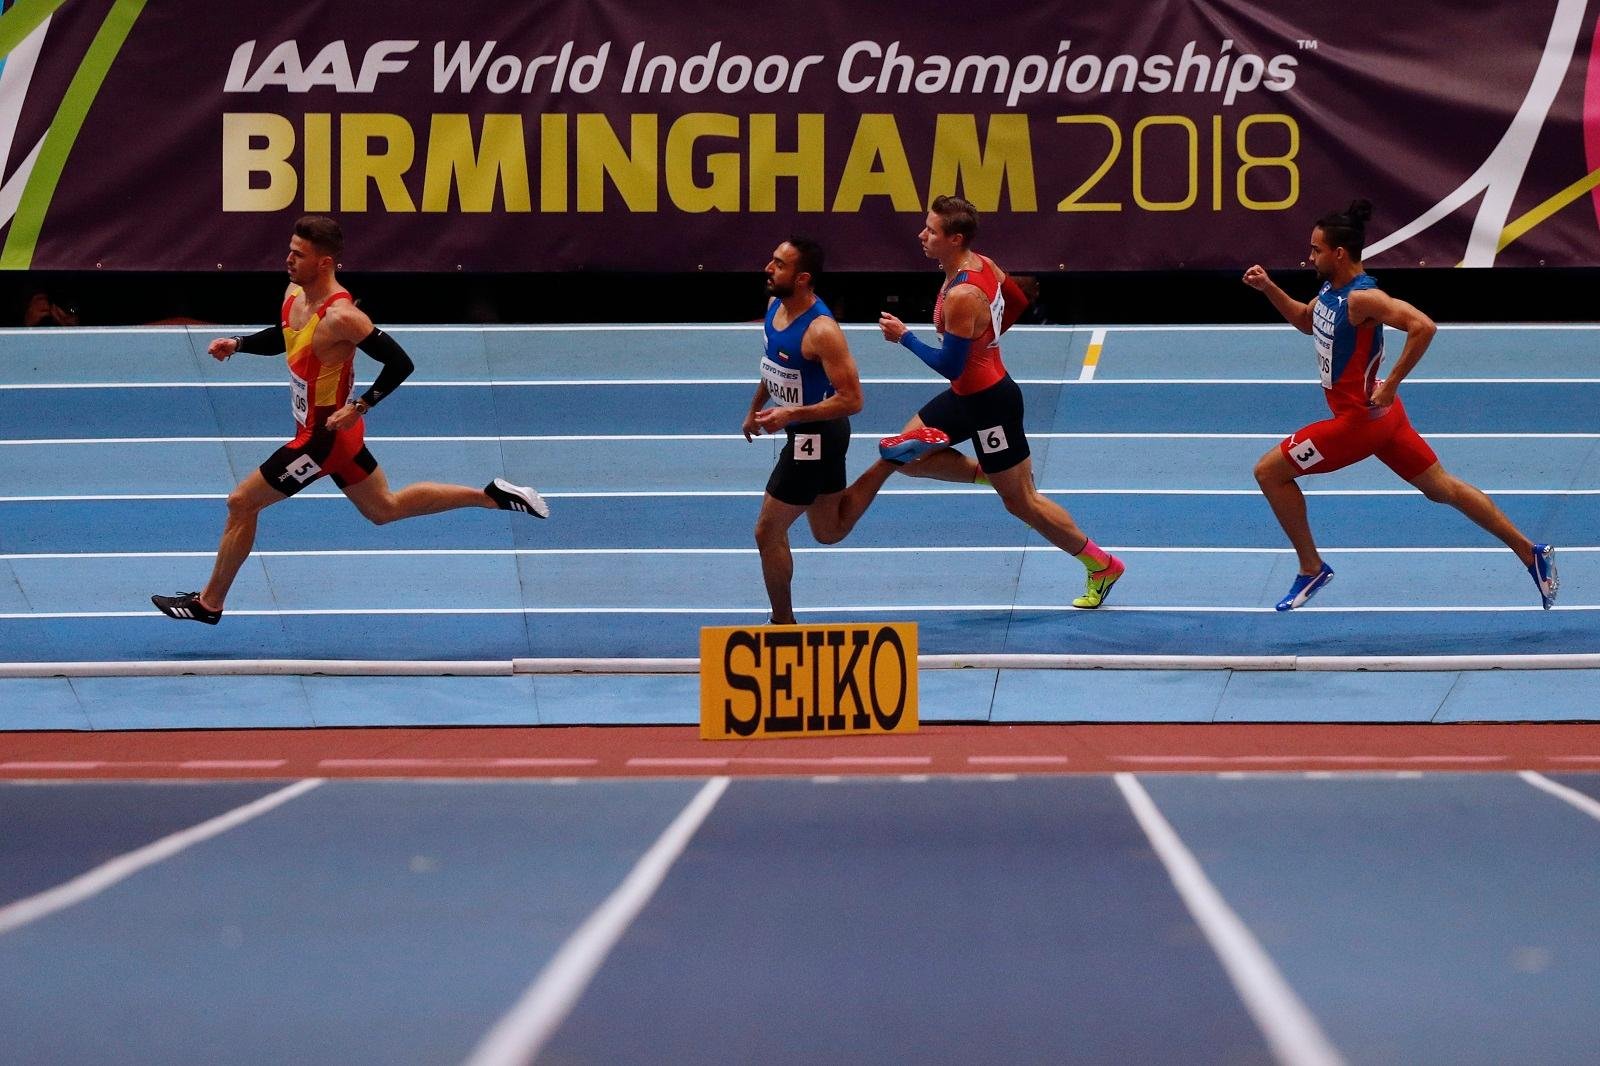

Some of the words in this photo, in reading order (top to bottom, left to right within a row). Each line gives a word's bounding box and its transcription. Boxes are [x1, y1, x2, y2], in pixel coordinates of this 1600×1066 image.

[223, 40, 420, 93] IAAF
[433, 41, 612, 94] World
[621, 41, 825, 94] Indoor
[837, 40, 1298, 106] Championships
[222, 112, 1038, 213] BIRMINGHAM
[1056, 114, 1301, 212] 2018
[764, 377, 799, 404] ARAM
[801, 439, 814, 456] 4
[987, 431, 1001, 449] 6
[1297, 448, 1315, 462] 3
[295, 462, 314, 476] 5
[724, 626, 907, 737] SEIKO
